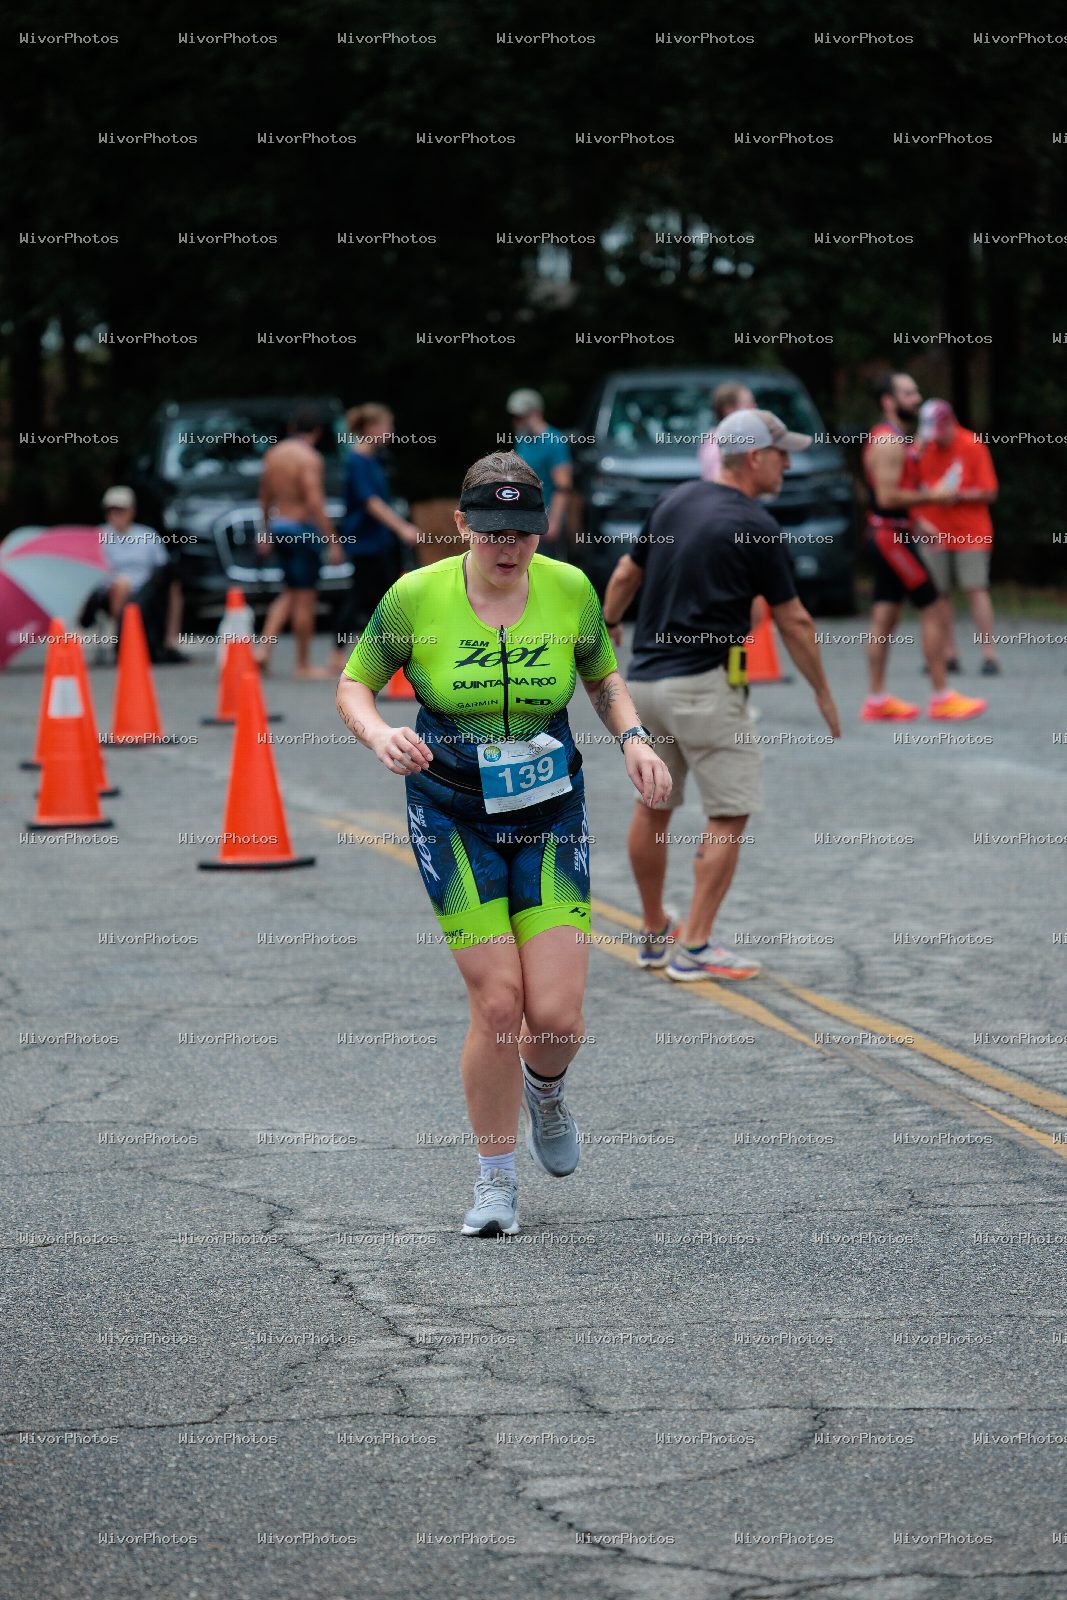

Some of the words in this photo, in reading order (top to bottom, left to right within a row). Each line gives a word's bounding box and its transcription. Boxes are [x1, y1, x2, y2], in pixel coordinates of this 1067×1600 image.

[459, 639, 490, 648] TEAM
[452, 677, 530, 690] QUINTANA
[530, 676, 557, 687] ROO
[457, 699, 499, 709] GARMIN
[498, 756, 555, 794] 139
